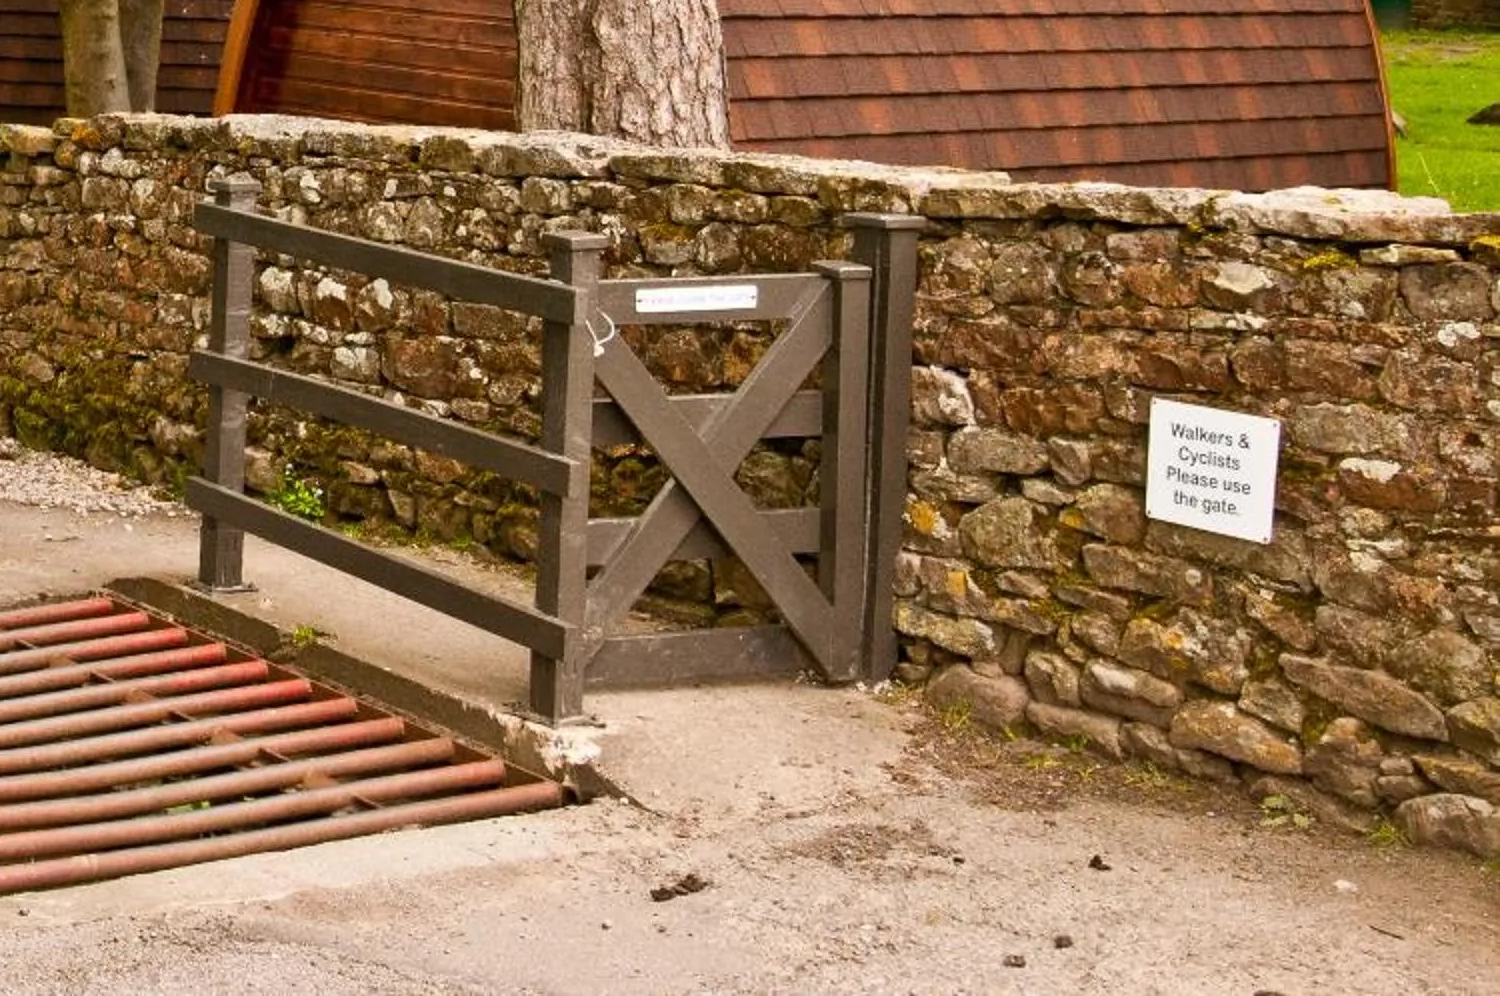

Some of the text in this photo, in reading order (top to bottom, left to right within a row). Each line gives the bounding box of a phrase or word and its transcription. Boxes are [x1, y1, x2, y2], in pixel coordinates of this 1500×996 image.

[1171, 423, 1250, 449] Walkers &
[1178, 445, 1240, 471] Cyclists
[1166, 465, 1251, 495] Please use
[1173, 490, 1198, 508] the
